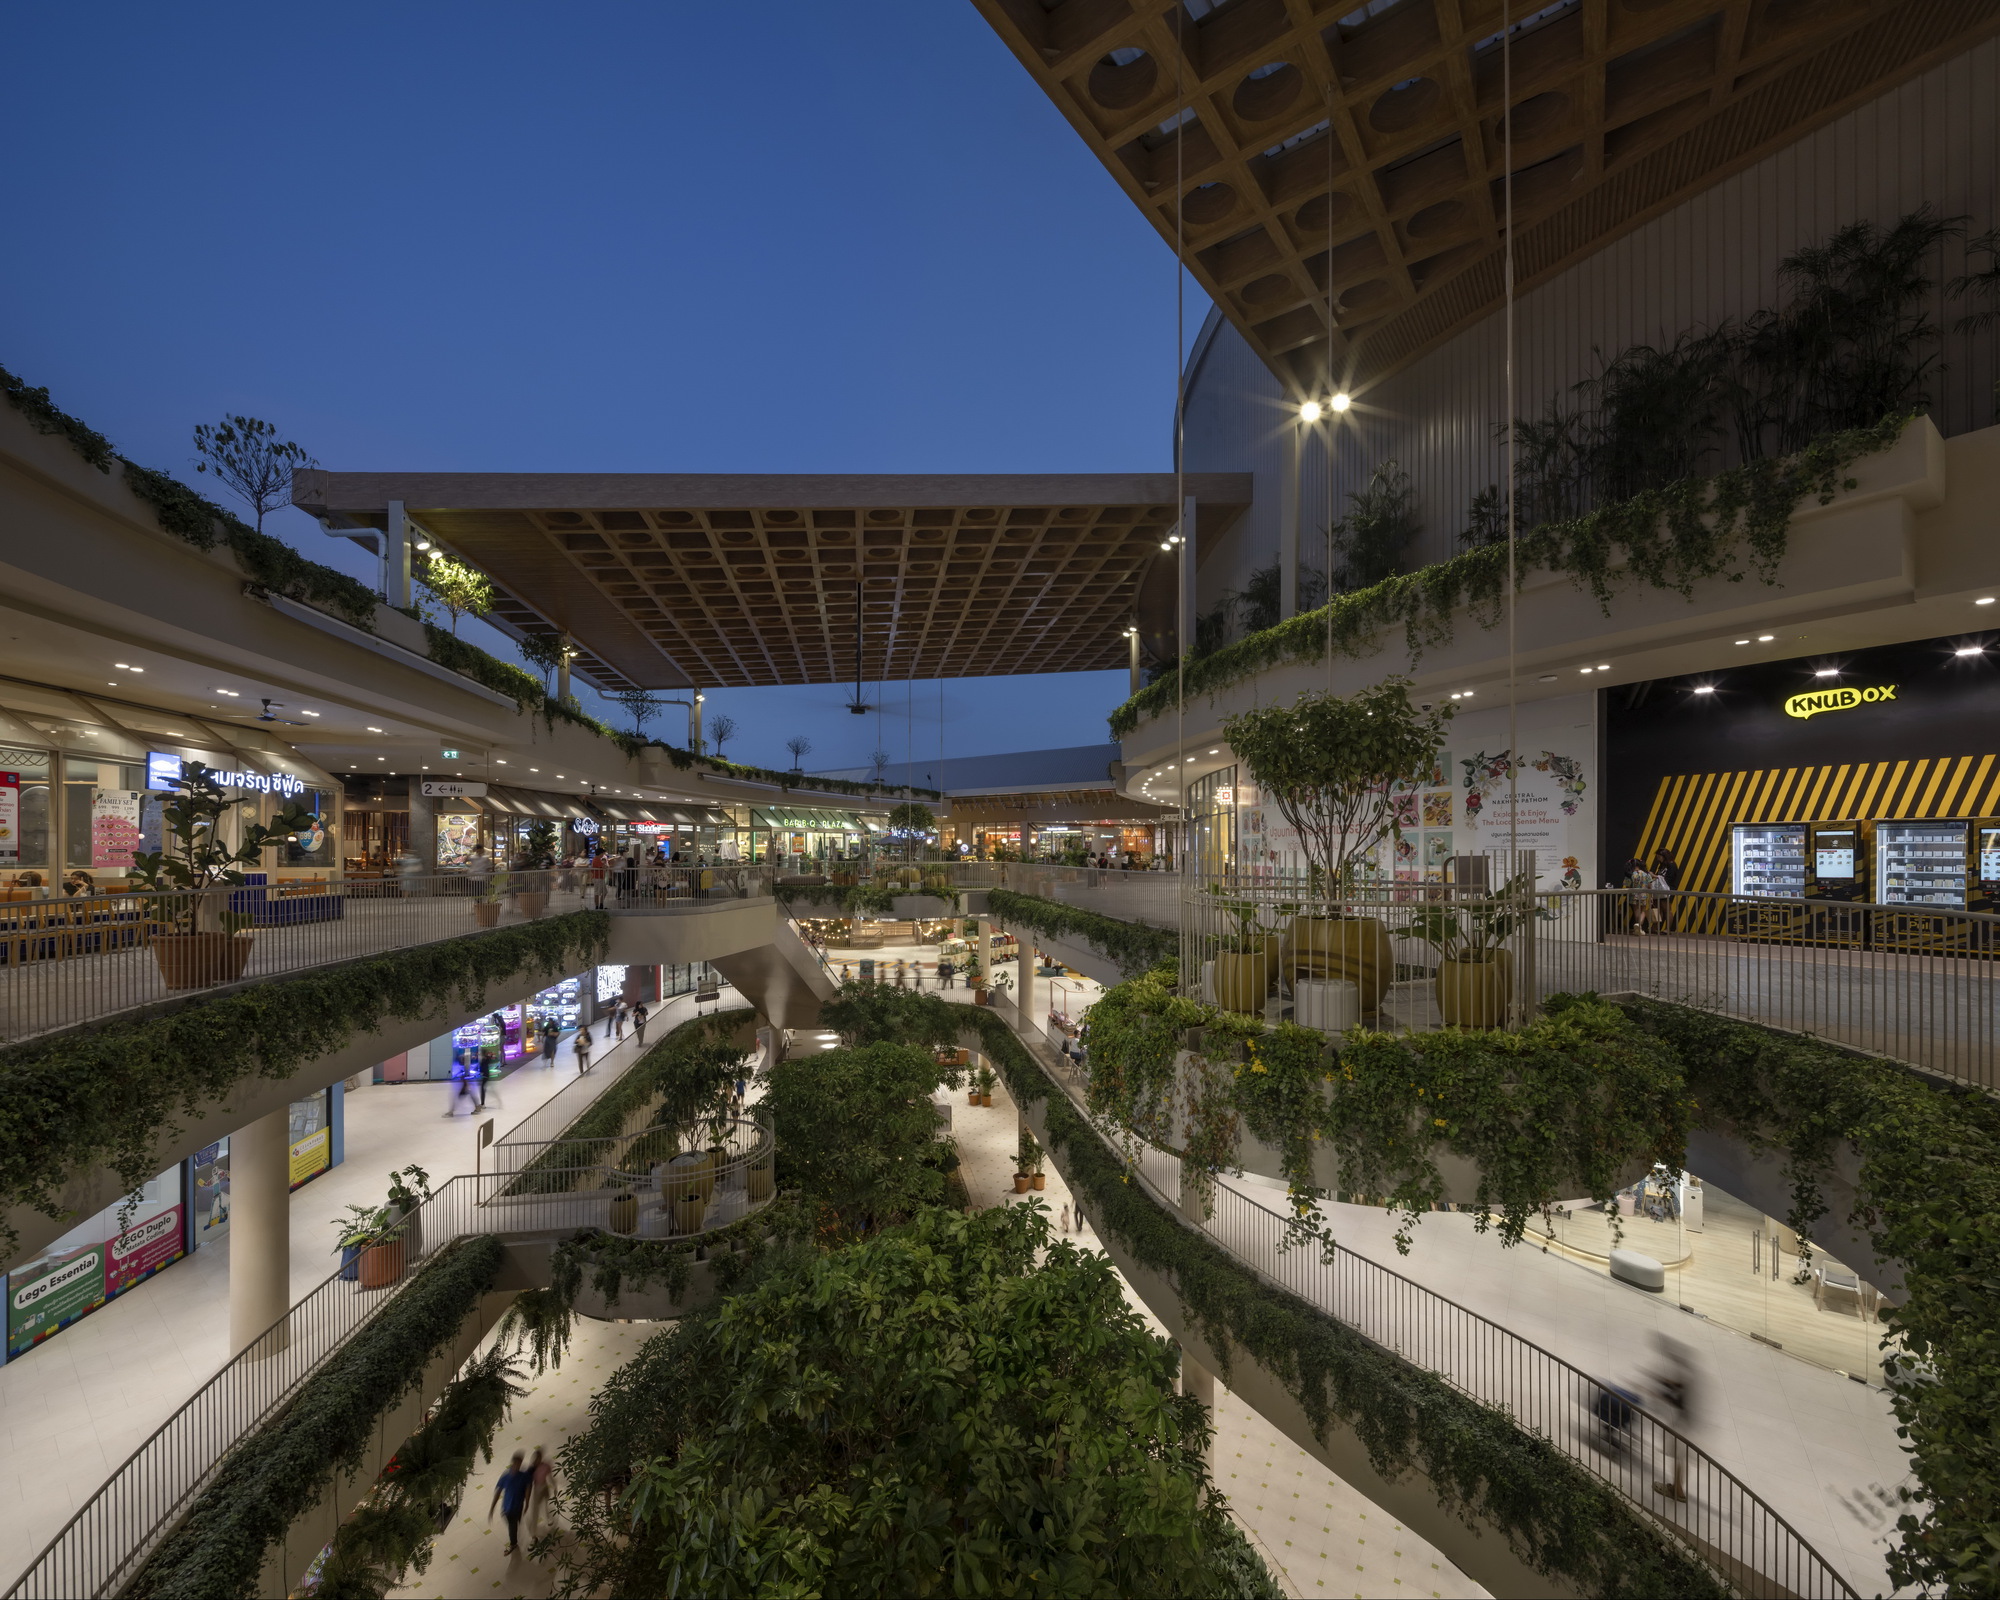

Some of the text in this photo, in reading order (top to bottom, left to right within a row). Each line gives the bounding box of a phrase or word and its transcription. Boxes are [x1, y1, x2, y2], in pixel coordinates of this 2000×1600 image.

[1792, 684, 1897, 713] KNUBOX
[272, 771, 304, 799] ซีฟู้ด
[424, 783, 433, 795] 2
[1527, 809, 1547, 817] Enjoy
[146, 1216, 172, 1235] Duplo
[18, 1284, 47, 1305] Lego
[49, 1255, 96, 1288] Essential
